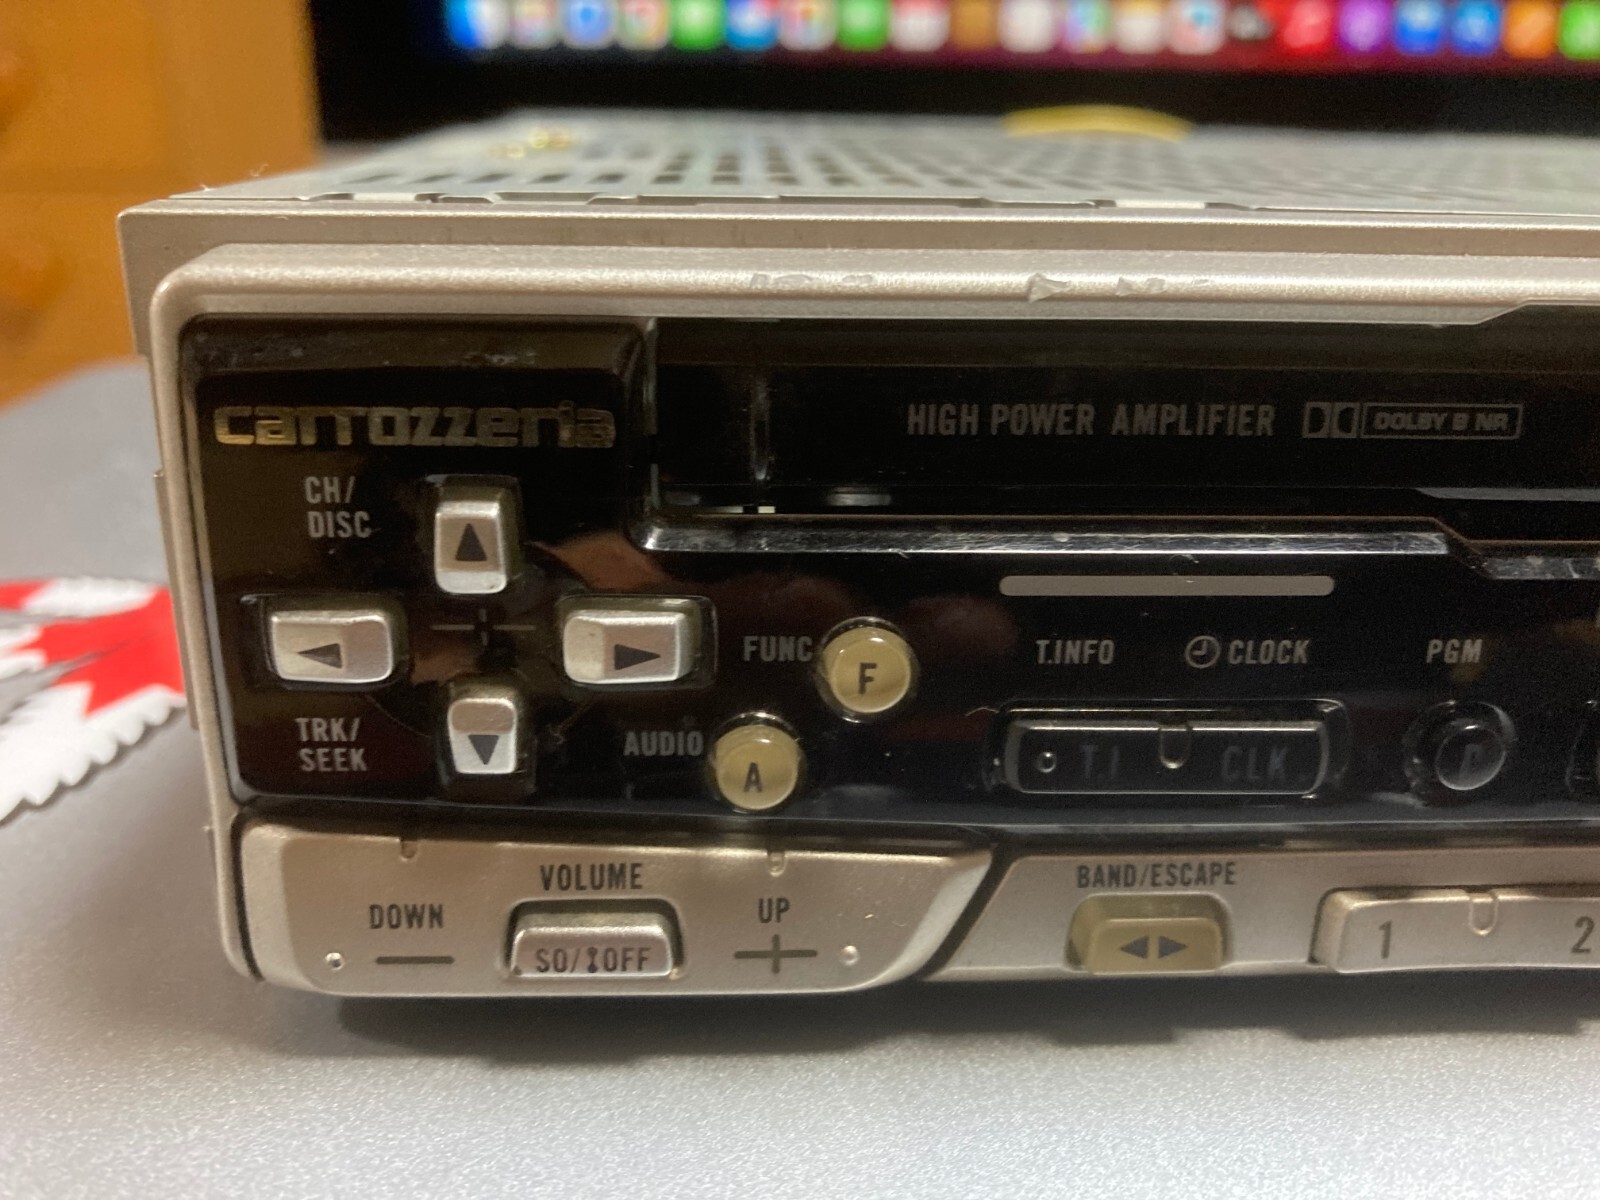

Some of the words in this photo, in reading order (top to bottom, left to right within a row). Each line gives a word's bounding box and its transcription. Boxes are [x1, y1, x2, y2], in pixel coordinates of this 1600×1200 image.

[907, 403, 979, 436] HIGH
[991, 403, 1094, 436] POWER
[1111, 404, 1275, 437] AMPLIFIER
[1373, 412, 1446, 432] DOLBY
[1475, 413, 1510, 432] NR
[305, 476, 355, 504] CH/
[308, 511, 371, 539] DISC
[743, 635, 813, 662] FUNC
[1036, 640, 1115, 665] T.INFO
[1228, 639, 1309, 665] CLOCK
[1426, 639, 1483, 665] PGM
[857, 662, 878, 695] F
[296, 717, 360, 743] TRK/
[624, 731, 704, 757] AUDIO
[300, 747, 368, 772] SEEK
[1221, 745, 1288, 782] CLK
[743, 762, 763, 793] A
[540, 863, 643, 891] VOLUME
[1077, 863, 1235, 888] BAND/ESCAPE
[369, 904, 444, 930] DOWN
[758, 897, 791, 925] UP
[1380, 921, 1392, 959] 1
[1571, 916, 1595, 955] 2
